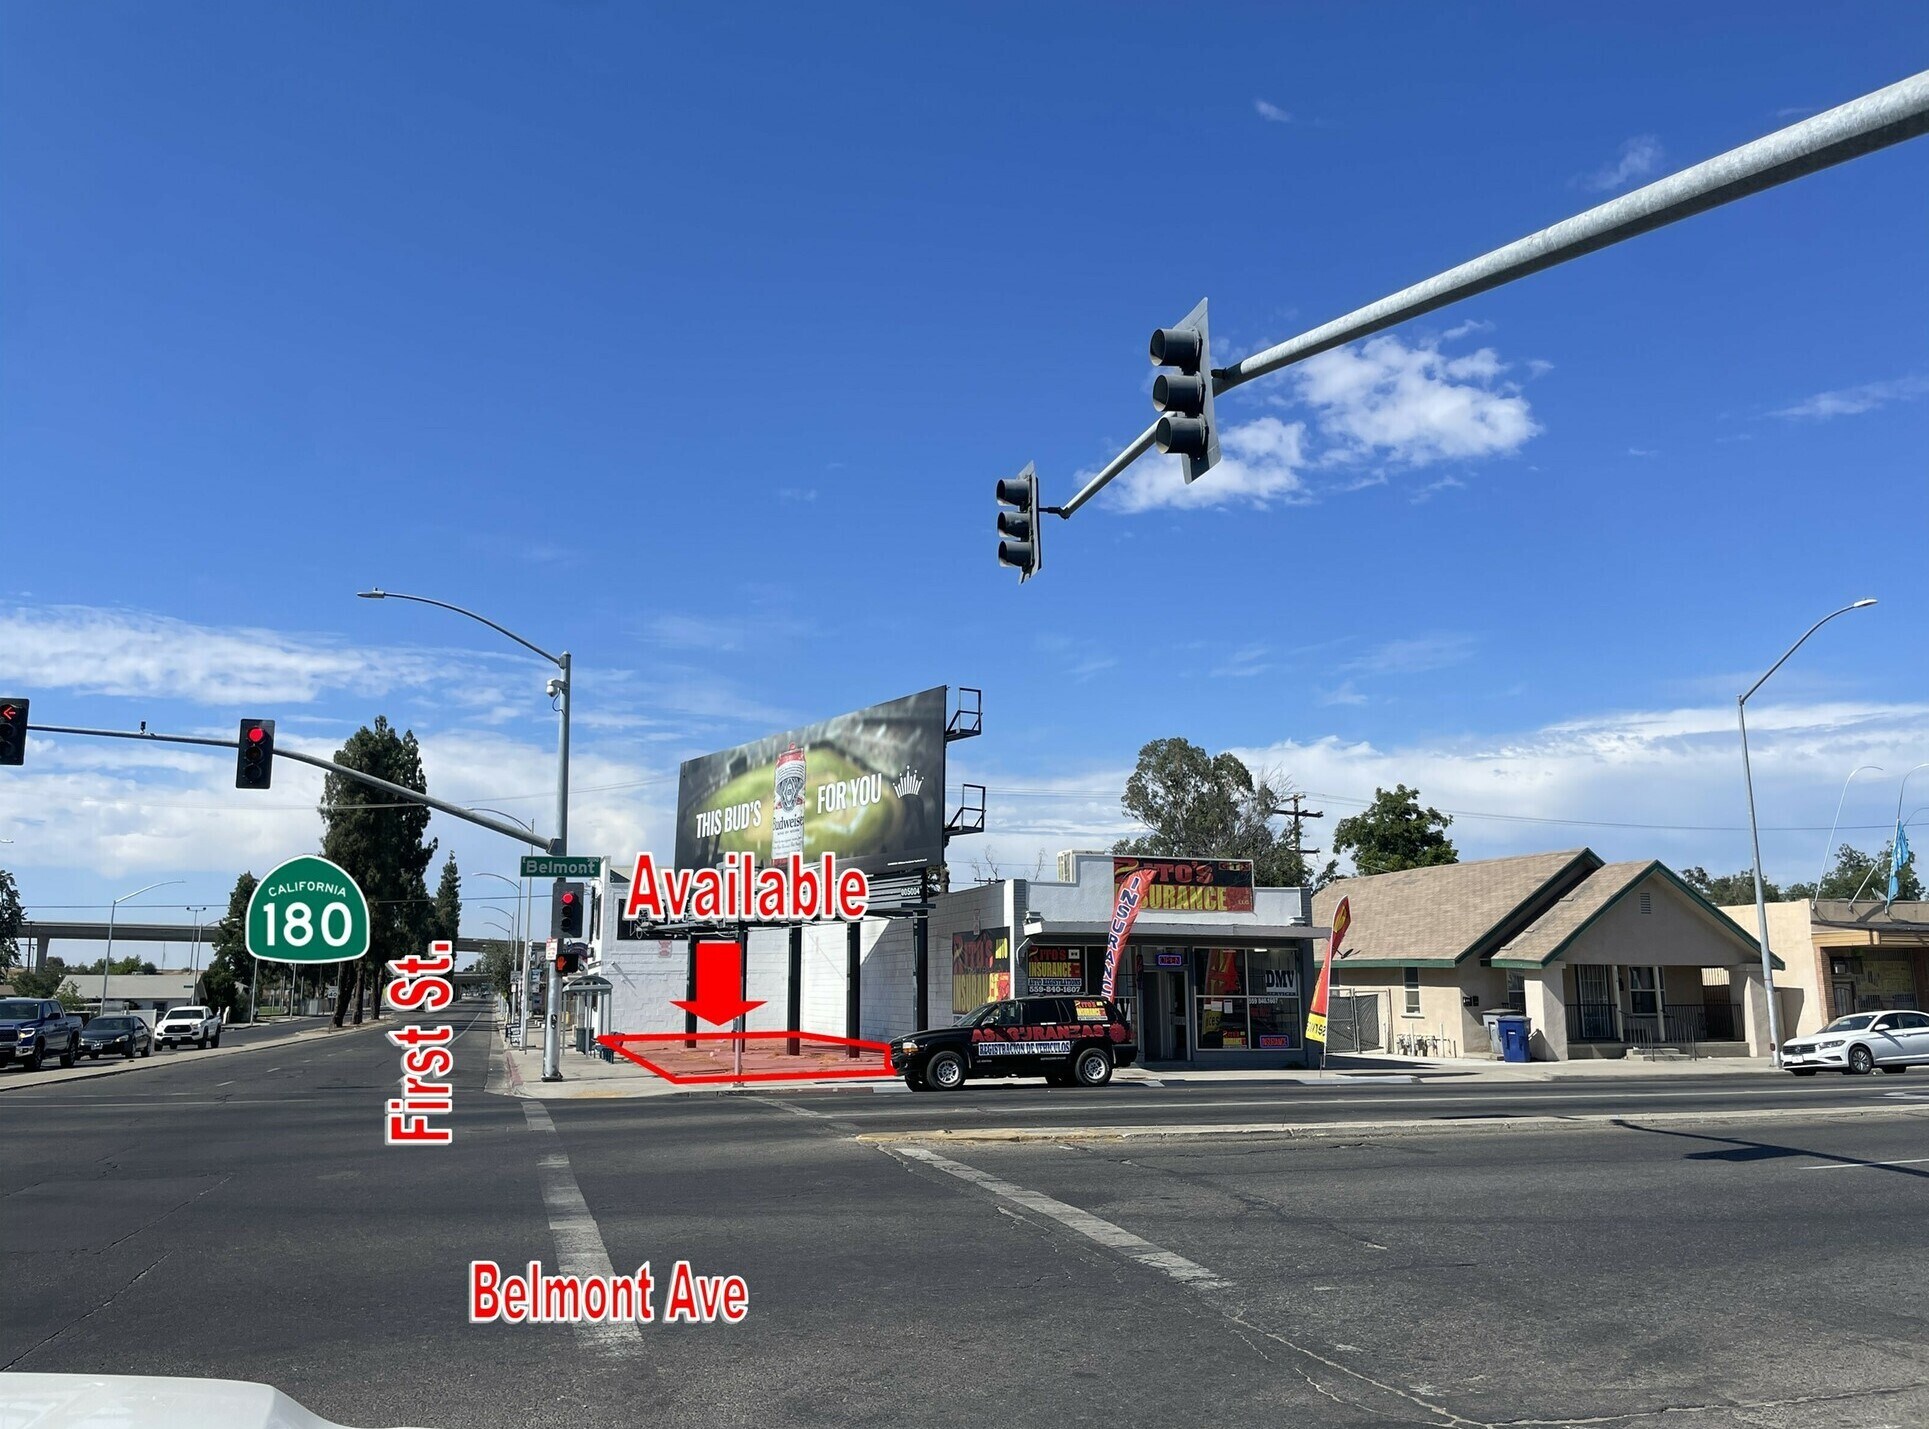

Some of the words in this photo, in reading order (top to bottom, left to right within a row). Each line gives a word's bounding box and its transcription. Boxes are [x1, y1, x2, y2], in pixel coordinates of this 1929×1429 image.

[817, 782, 847, 814] FOR
[849, 773, 882, 807] YOU
[696, 808, 722, 838] THIS
[724, 800, 761, 833] BUD'S
[773, 814, 804, 831] Budweise
[526, 860, 595, 874] Belmont
[1114, 858, 1213, 884] RTO'S
[901, 887, 920, 896] 005004
[1101, 876, 1140, 1001] INSURANC
[1029, 962, 1072, 977] INSURANCE
[1265, 970, 1295, 988] DMV
[971, 1025, 1105, 1043] ASGURANZAS
[979, 1043, 1025, 1055] REGISTRACION
[1026, 1042, 1035, 1054] DE
[1036, 1041, 1070, 1053] VEHICULOS
